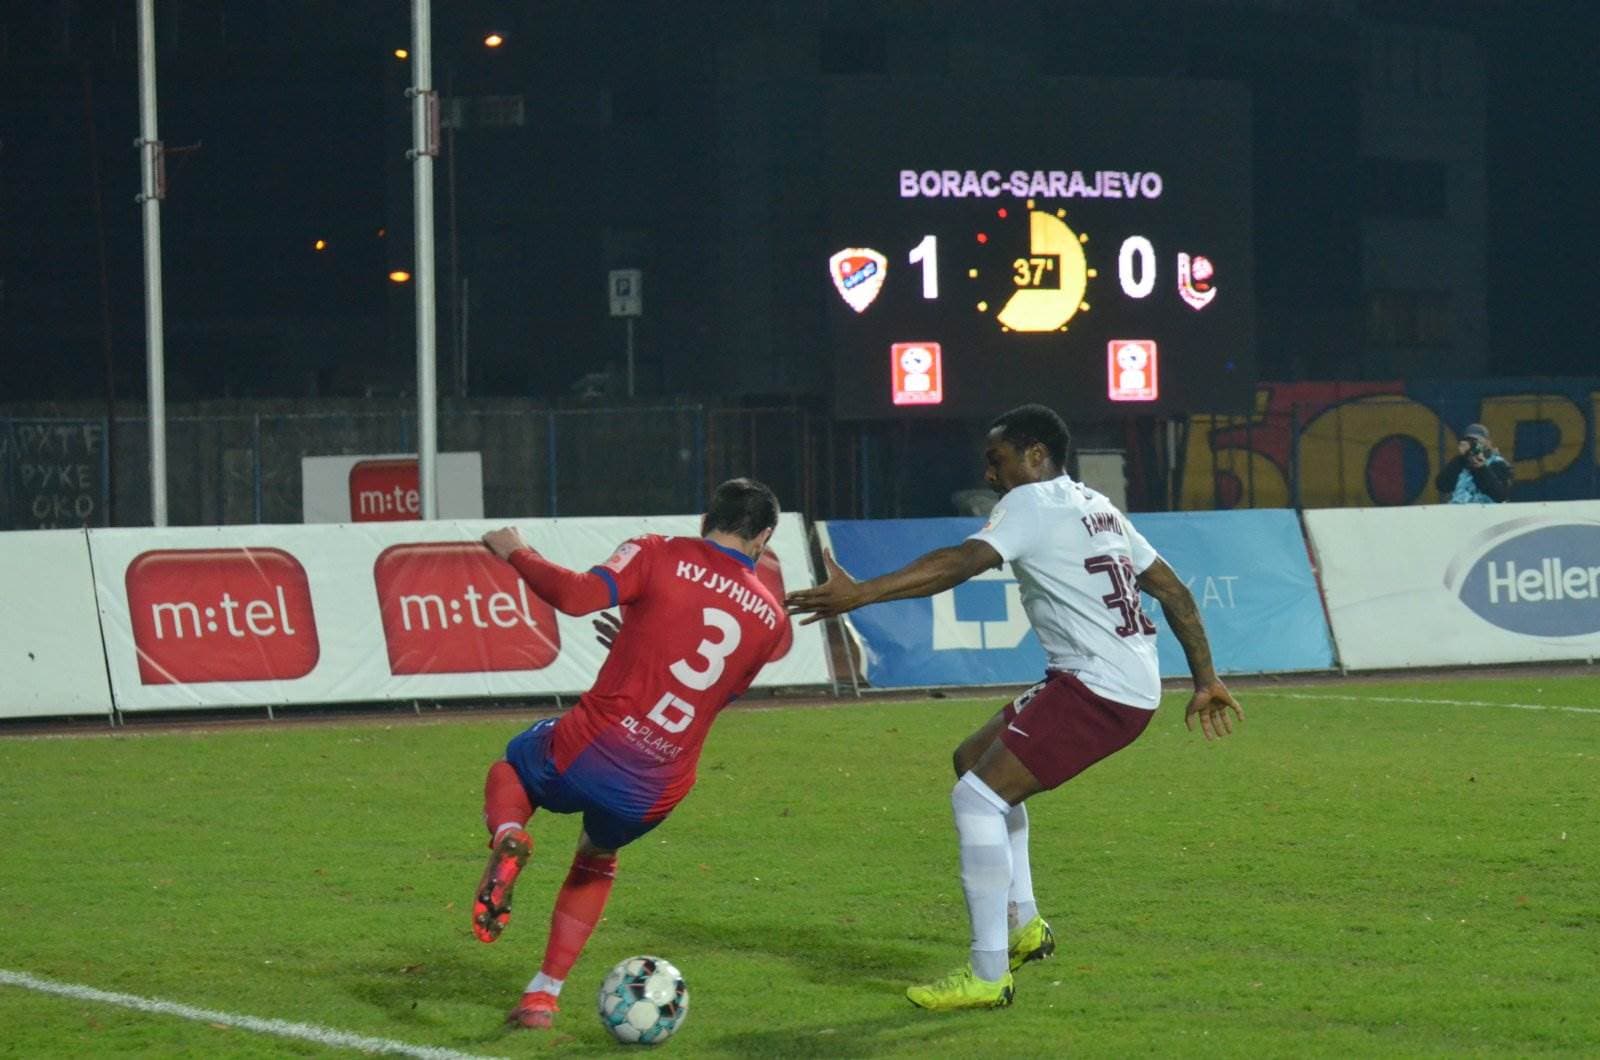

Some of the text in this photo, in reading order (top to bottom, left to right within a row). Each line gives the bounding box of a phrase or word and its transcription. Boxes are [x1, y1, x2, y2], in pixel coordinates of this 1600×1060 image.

[900, 170, 1163, 199] BORAC-SARAJEVO
[908, 234, 939, 299] 1
[1118, 235, 1157, 298] 0
[359, 485, 420, 514] m:te
[151, 585, 296, 640] m:tel
[399, 577, 537, 632] m:tel
[669, 607, 742, 691] 3
